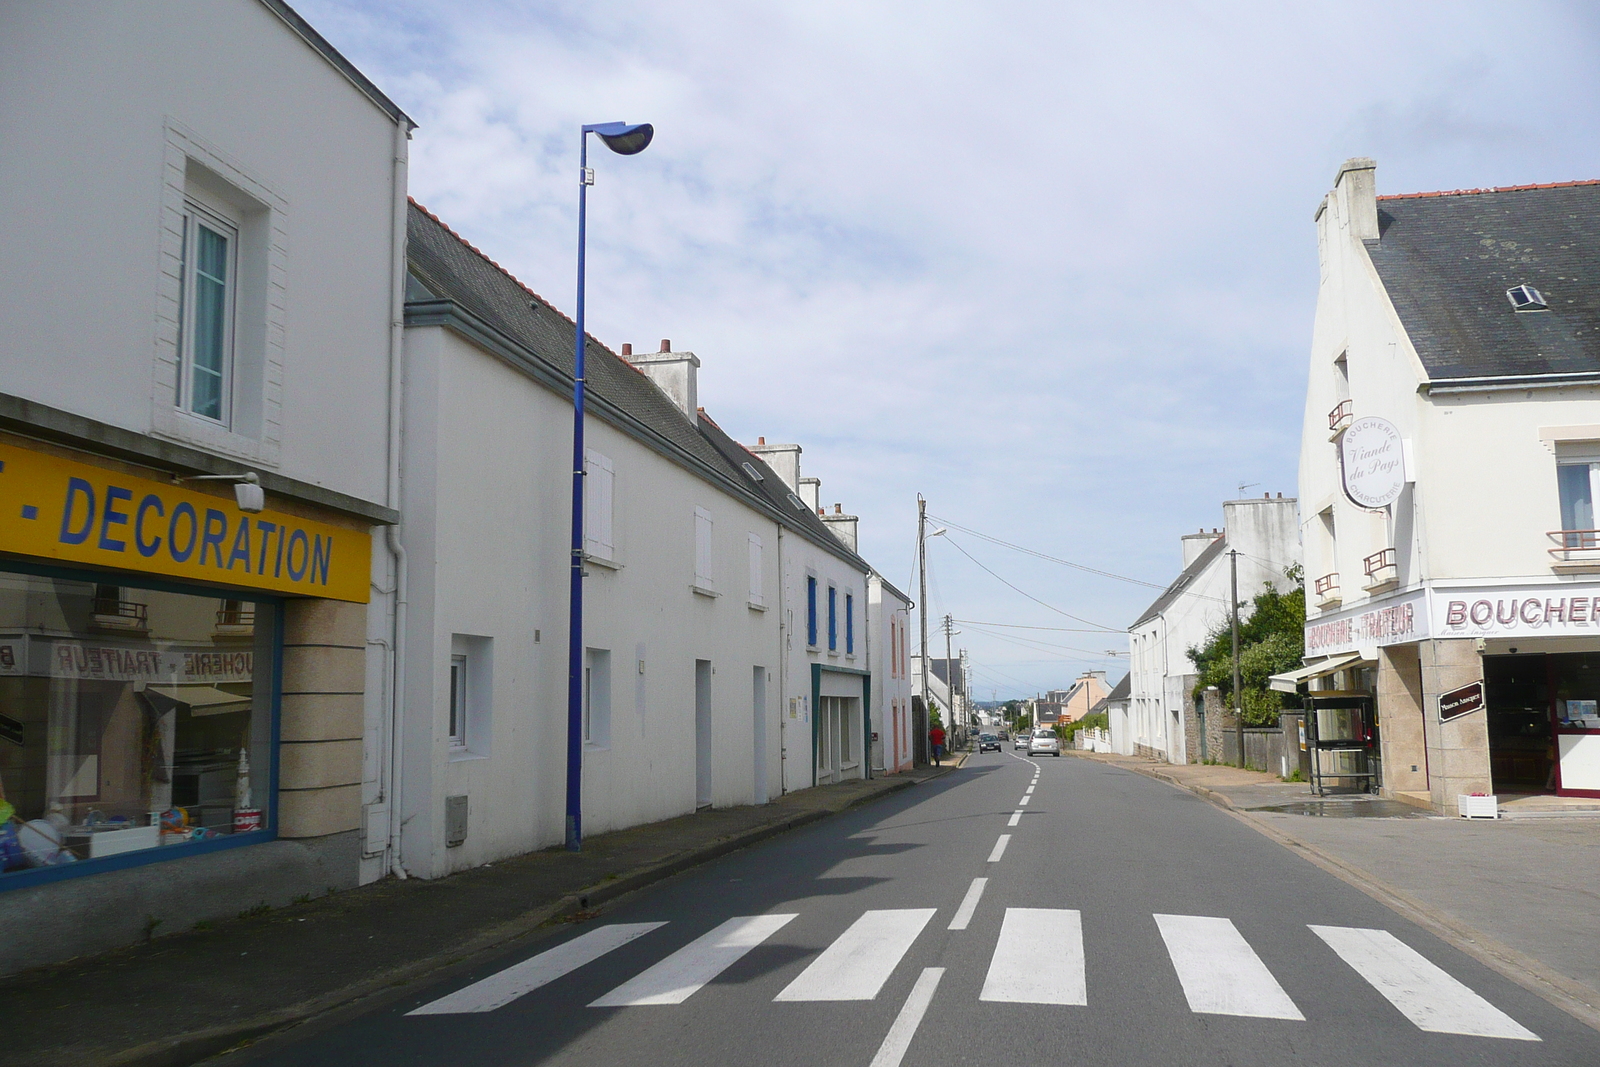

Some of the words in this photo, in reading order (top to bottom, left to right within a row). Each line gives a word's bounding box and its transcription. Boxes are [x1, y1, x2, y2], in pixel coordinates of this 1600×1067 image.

[1346, 422, 1397, 443] BOUCHERIE
[1349, 440, 1391, 463] Viande
[1350, 466, 1364, 481] du
[1368, 458, 1399, 474] Pays
[1350, 481, 1400, 503] CHARCUTERIE
[58, 477, 332, 586] DECORATION
[1308, 618, 1353, 648] BOUCHERIE
[1361, 603, 1414, 639] TRAITEUR
